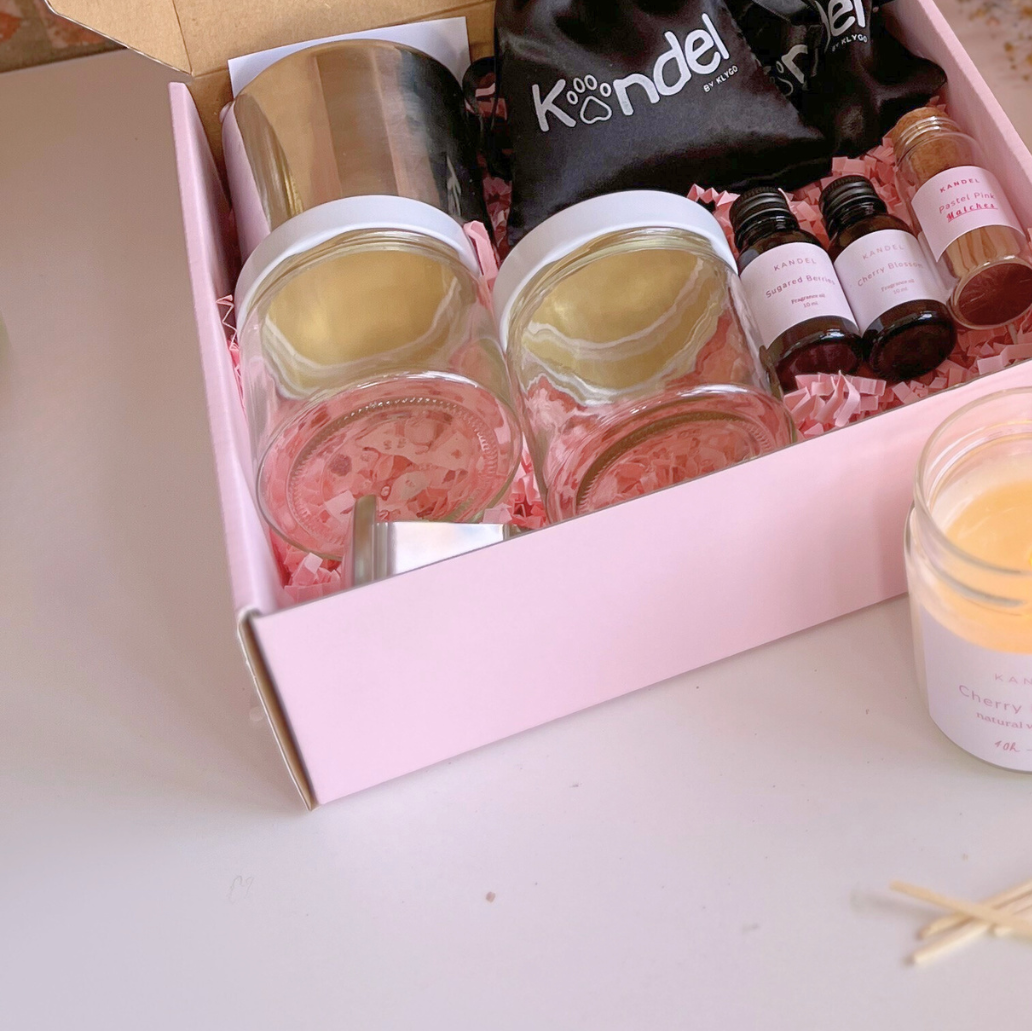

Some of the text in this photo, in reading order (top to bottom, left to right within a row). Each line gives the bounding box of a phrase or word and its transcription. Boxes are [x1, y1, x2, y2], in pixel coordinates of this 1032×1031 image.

[703, 65, 738, 93] BY KLYGO
[940, 178, 980, 194] KANDEL
[939, 192, 996, 215] Pastel Pink
[863, 243, 905, 260] KANDEL
[773, 257, 817, 272] KANDEL
[765, 276, 803, 298] Sugared
[857, 266, 885, 287] Cherry
[958, 684, 1022, 715] Cherry
[976, 712, 1022, 729] natural
